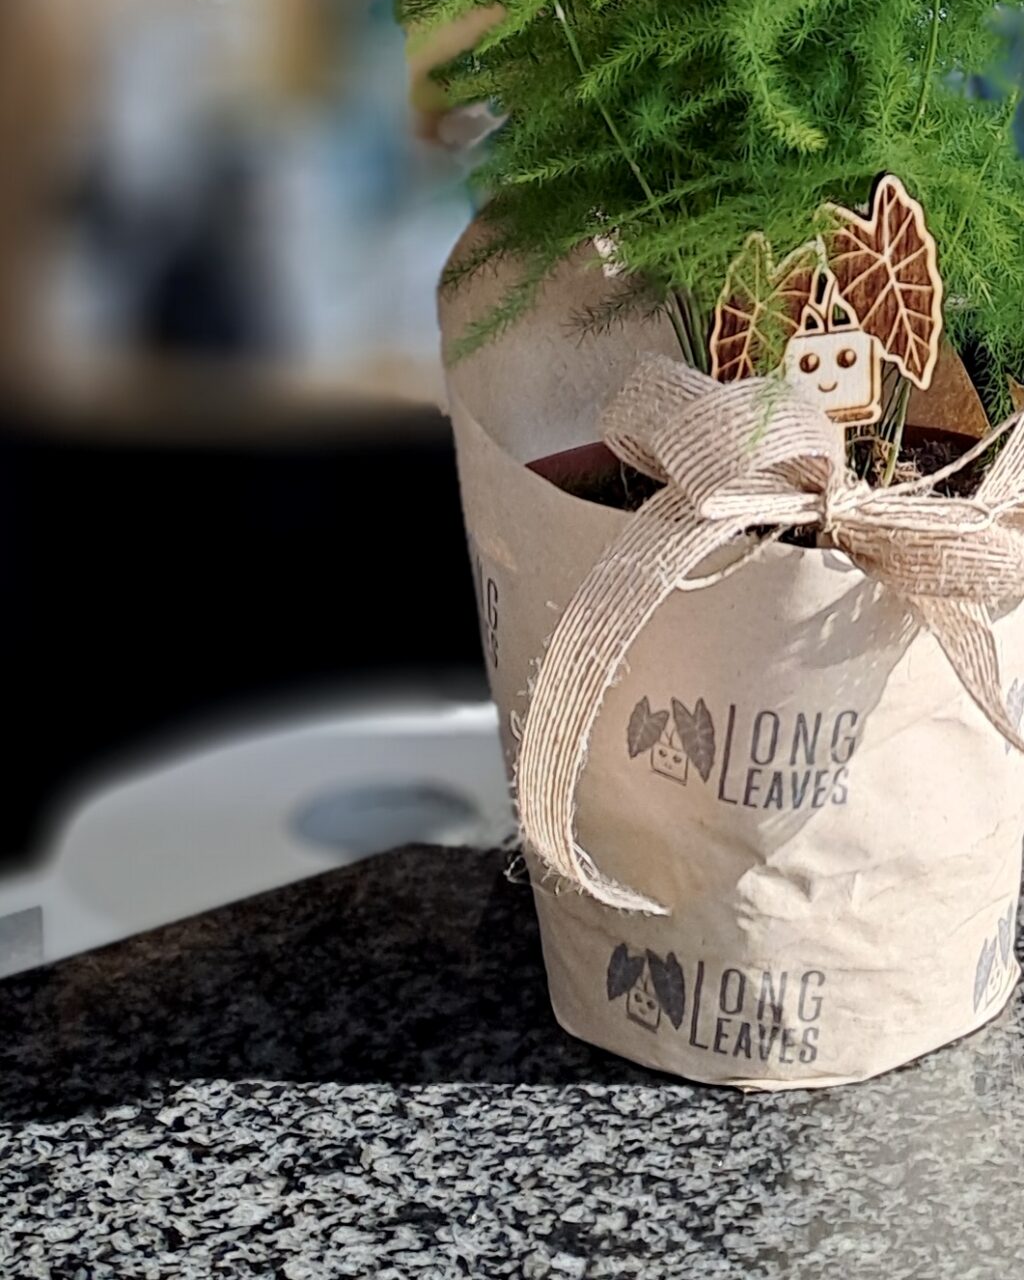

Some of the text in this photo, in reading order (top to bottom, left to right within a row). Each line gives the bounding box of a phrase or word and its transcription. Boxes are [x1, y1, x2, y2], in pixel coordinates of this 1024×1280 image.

[717, 704, 859, 767] LONG
[717, 766, 848, 810] LEAVES
[689, 960, 826, 1024] LONG
[689, 1017, 820, 1064] LEAVES
